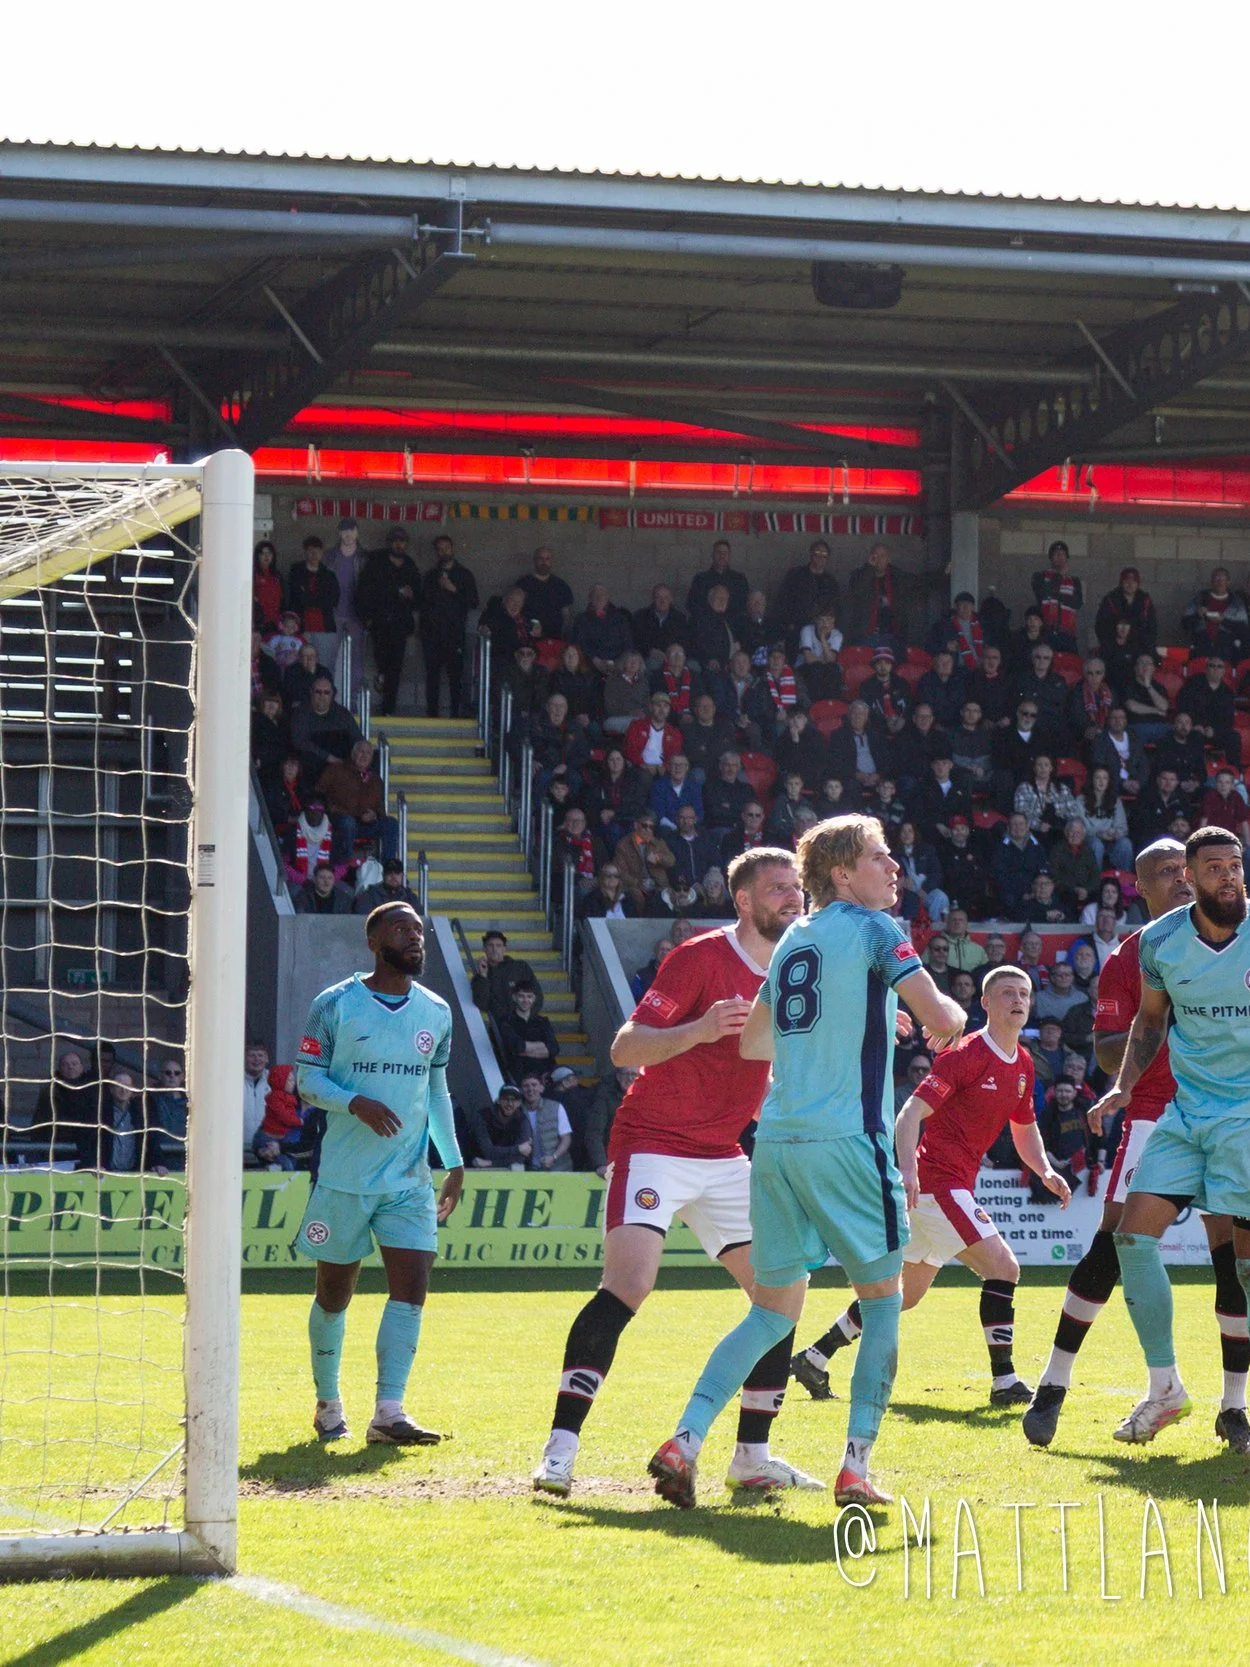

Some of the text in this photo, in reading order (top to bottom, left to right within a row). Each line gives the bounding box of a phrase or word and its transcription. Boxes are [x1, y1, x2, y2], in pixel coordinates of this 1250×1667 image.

[644, 511, 708, 527] UNITED
[775, 944, 823, 1037] 8
[1180, 1004, 1207, 1016] THE
[352, 1062, 428, 1076] THE PITMEN
[6, 1190, 290, 1231] PEVEL
[1019, 1213, 1045, 1222] one
[1010, 1230, 1025, 1239] at
[1029, 1231, 1038, 1239] a
[445, 1244, 492, 1261] LIC
